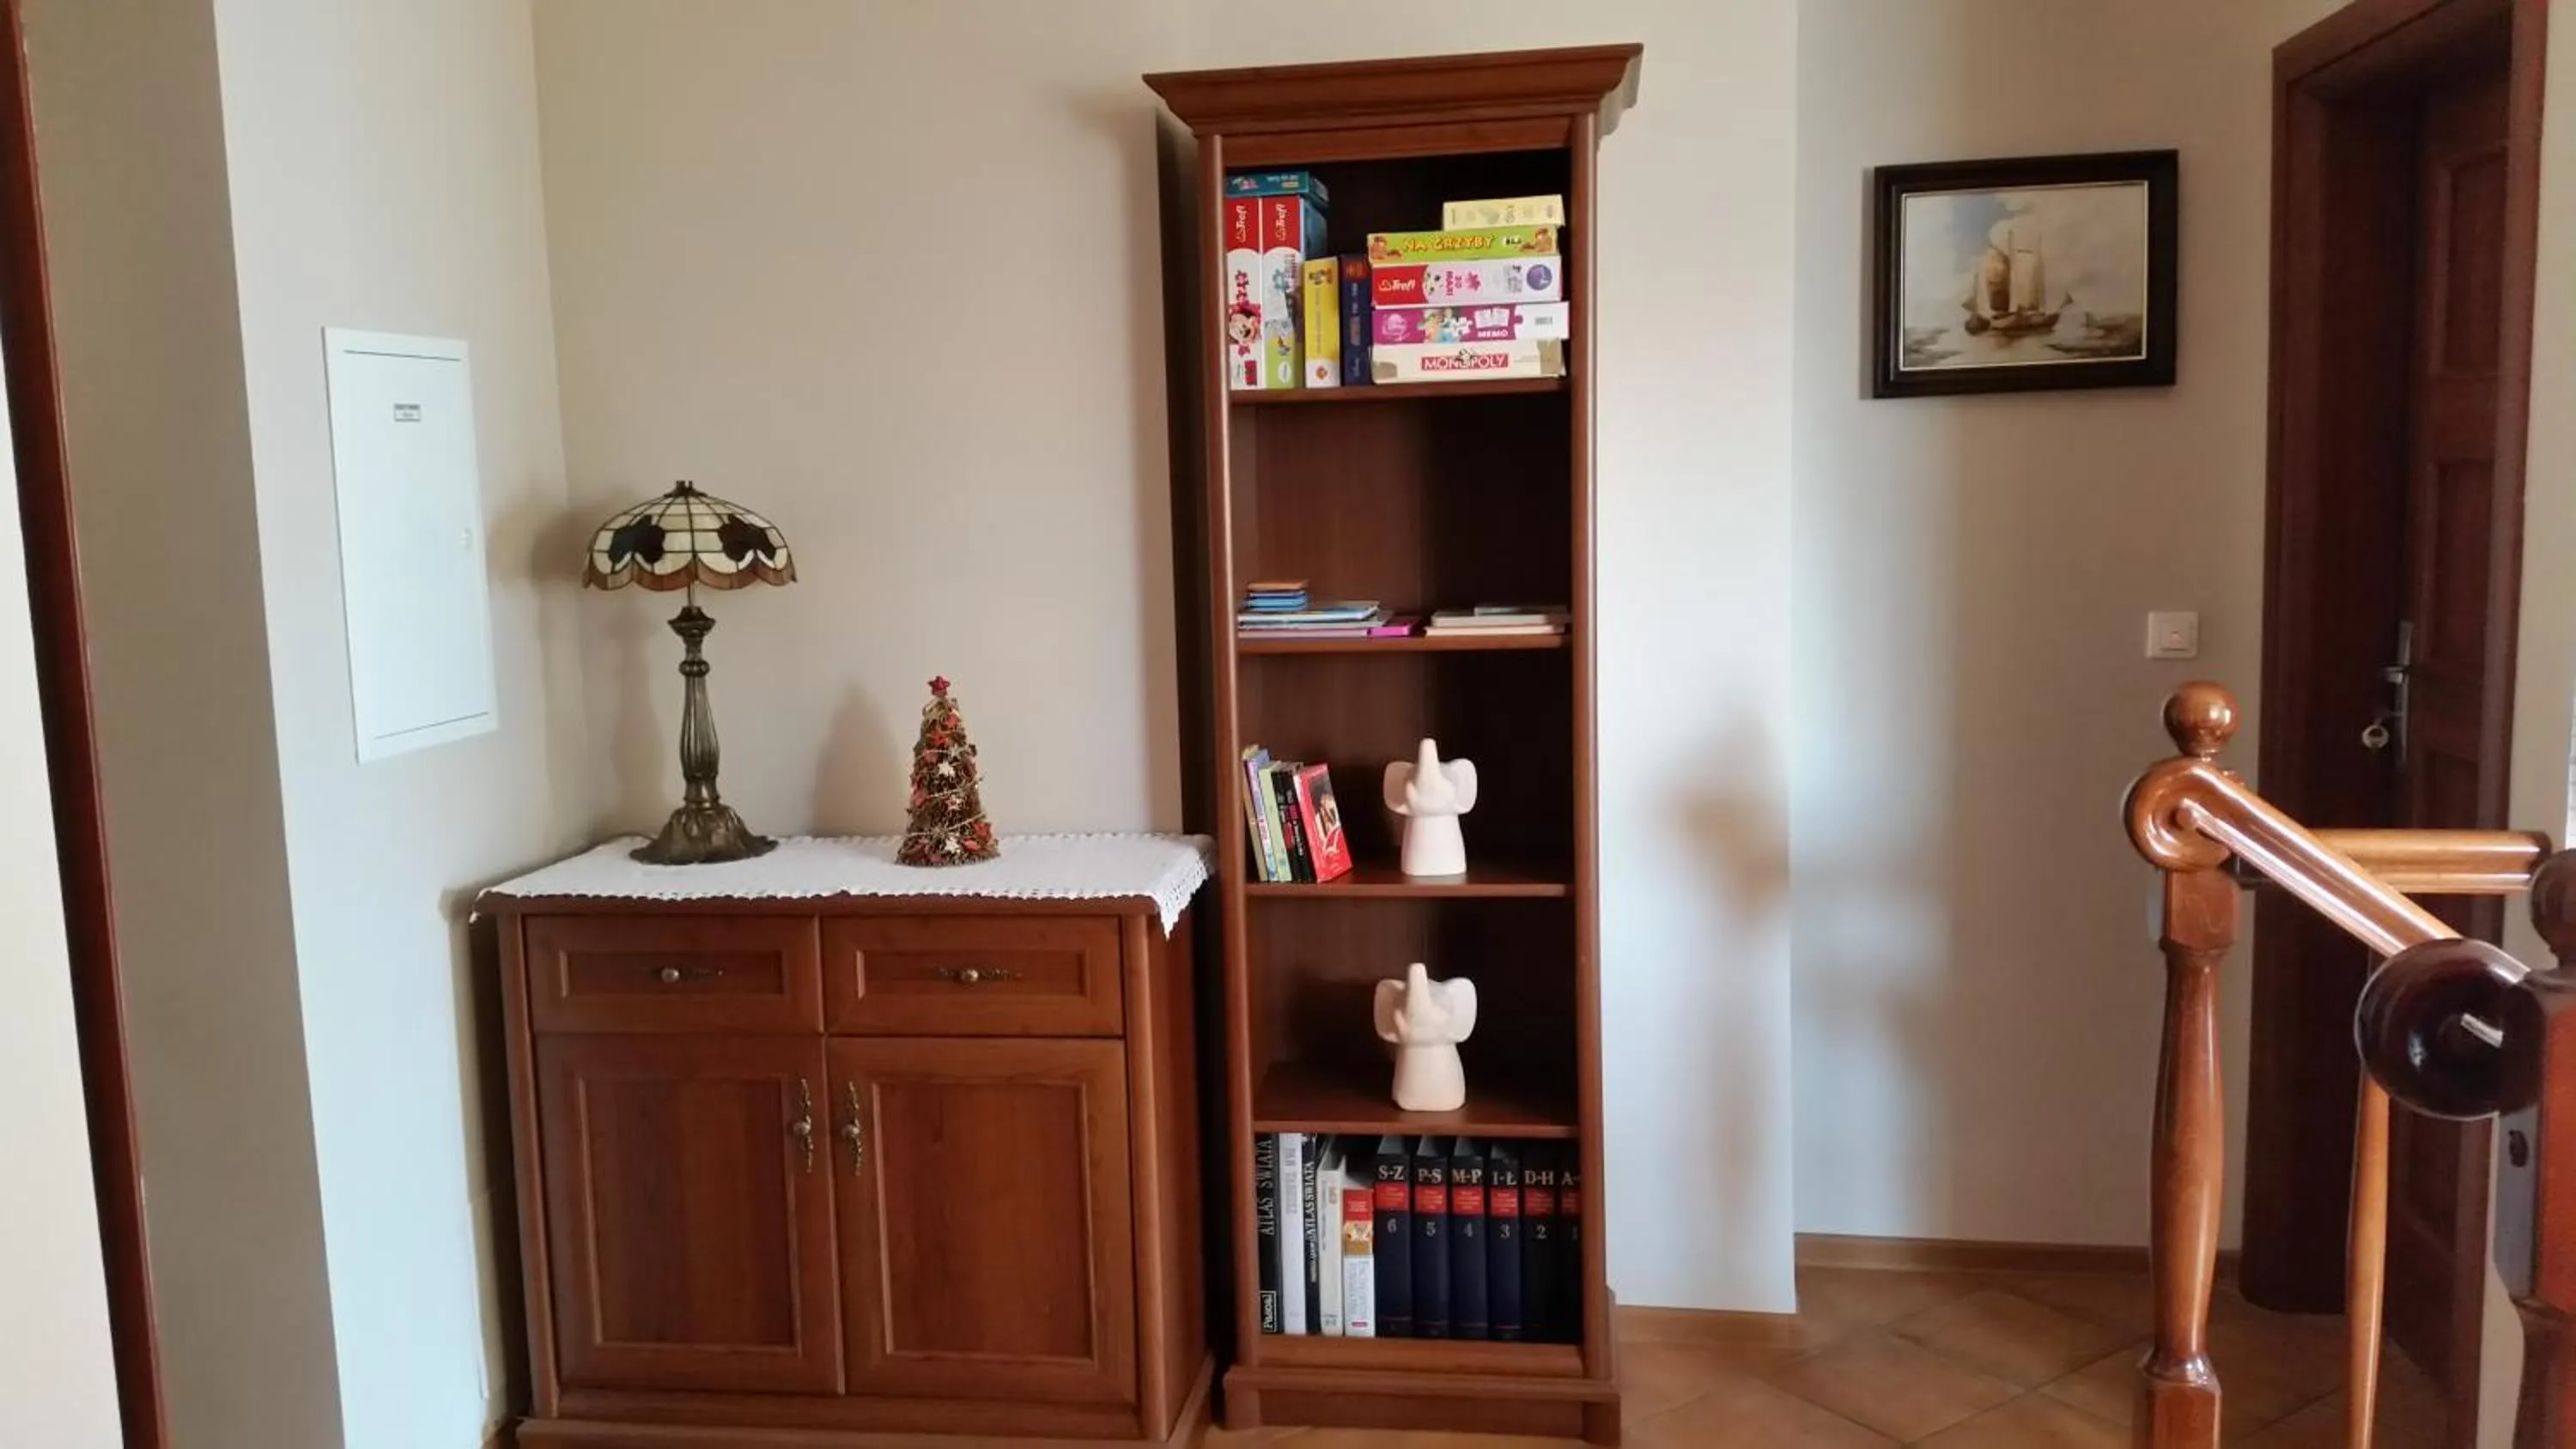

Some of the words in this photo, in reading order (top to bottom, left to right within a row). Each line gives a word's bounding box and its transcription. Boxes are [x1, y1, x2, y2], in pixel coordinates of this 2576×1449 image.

[1477, 329, 1509, 338] MEMO
[1378, 1165, 1405, 1181] S-Z
[1418, 1168, 1443, 1184] P-S
[1452, 1168, 1483, 1184] M-P
[1524, 1170, 1554, 1185] D-H
[1562, 1171, 1580, 1185] A-
[1258, 1197, 1275, 1235] ATLAS
[1304, 1202, 1316, 1235] ATLAS
[1387, 1218, 1397, 1234] 6
[1426, 1222, 1436, 1237] 5
[1463, 1222, 1473, 1237] 4
[1500, 1223, 1510, 1239] 3
[1536, 1223, 1547, 1240] 2
